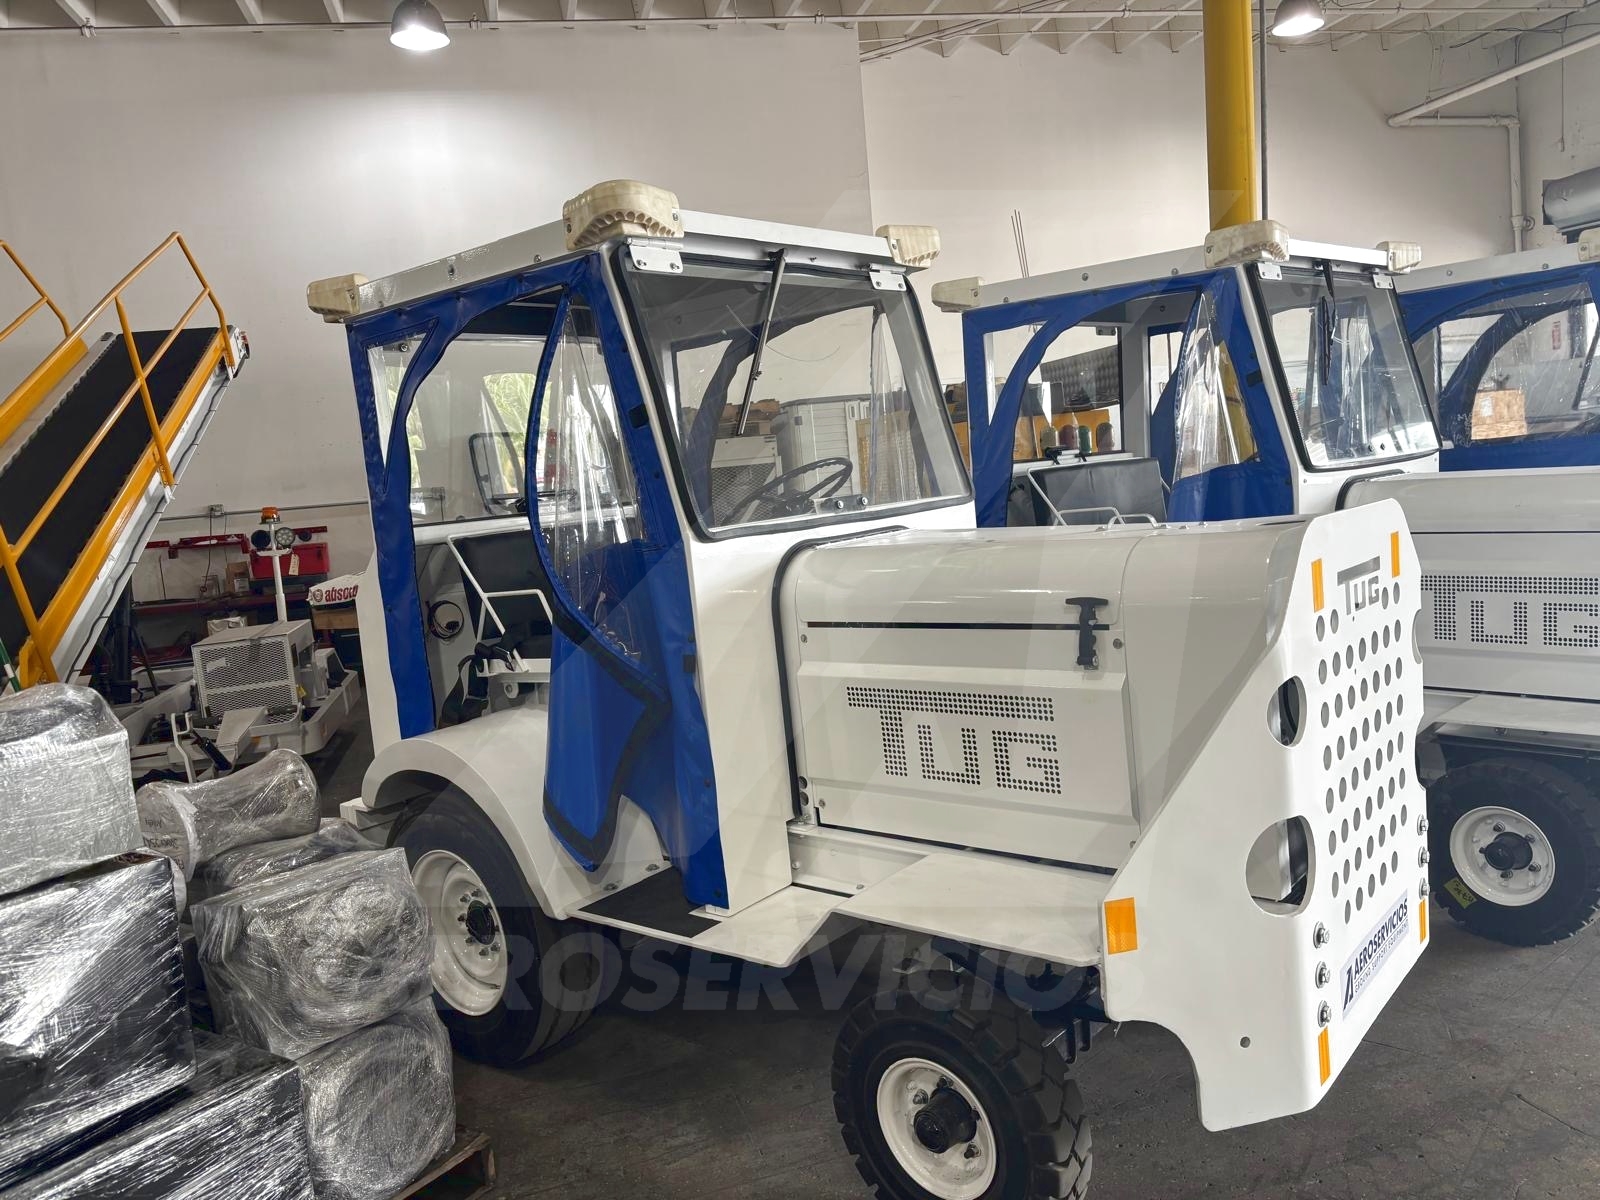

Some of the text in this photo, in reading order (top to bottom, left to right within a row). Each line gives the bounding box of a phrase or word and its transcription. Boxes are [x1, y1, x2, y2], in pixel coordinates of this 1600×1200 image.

[1337, 556, 1381, 615] TUG
[1421, 575, 1600, 648] TUG
[846, 686, 1062, 795] TUG
[1354, 898, 1408, 981] AEROSERVICIOS
